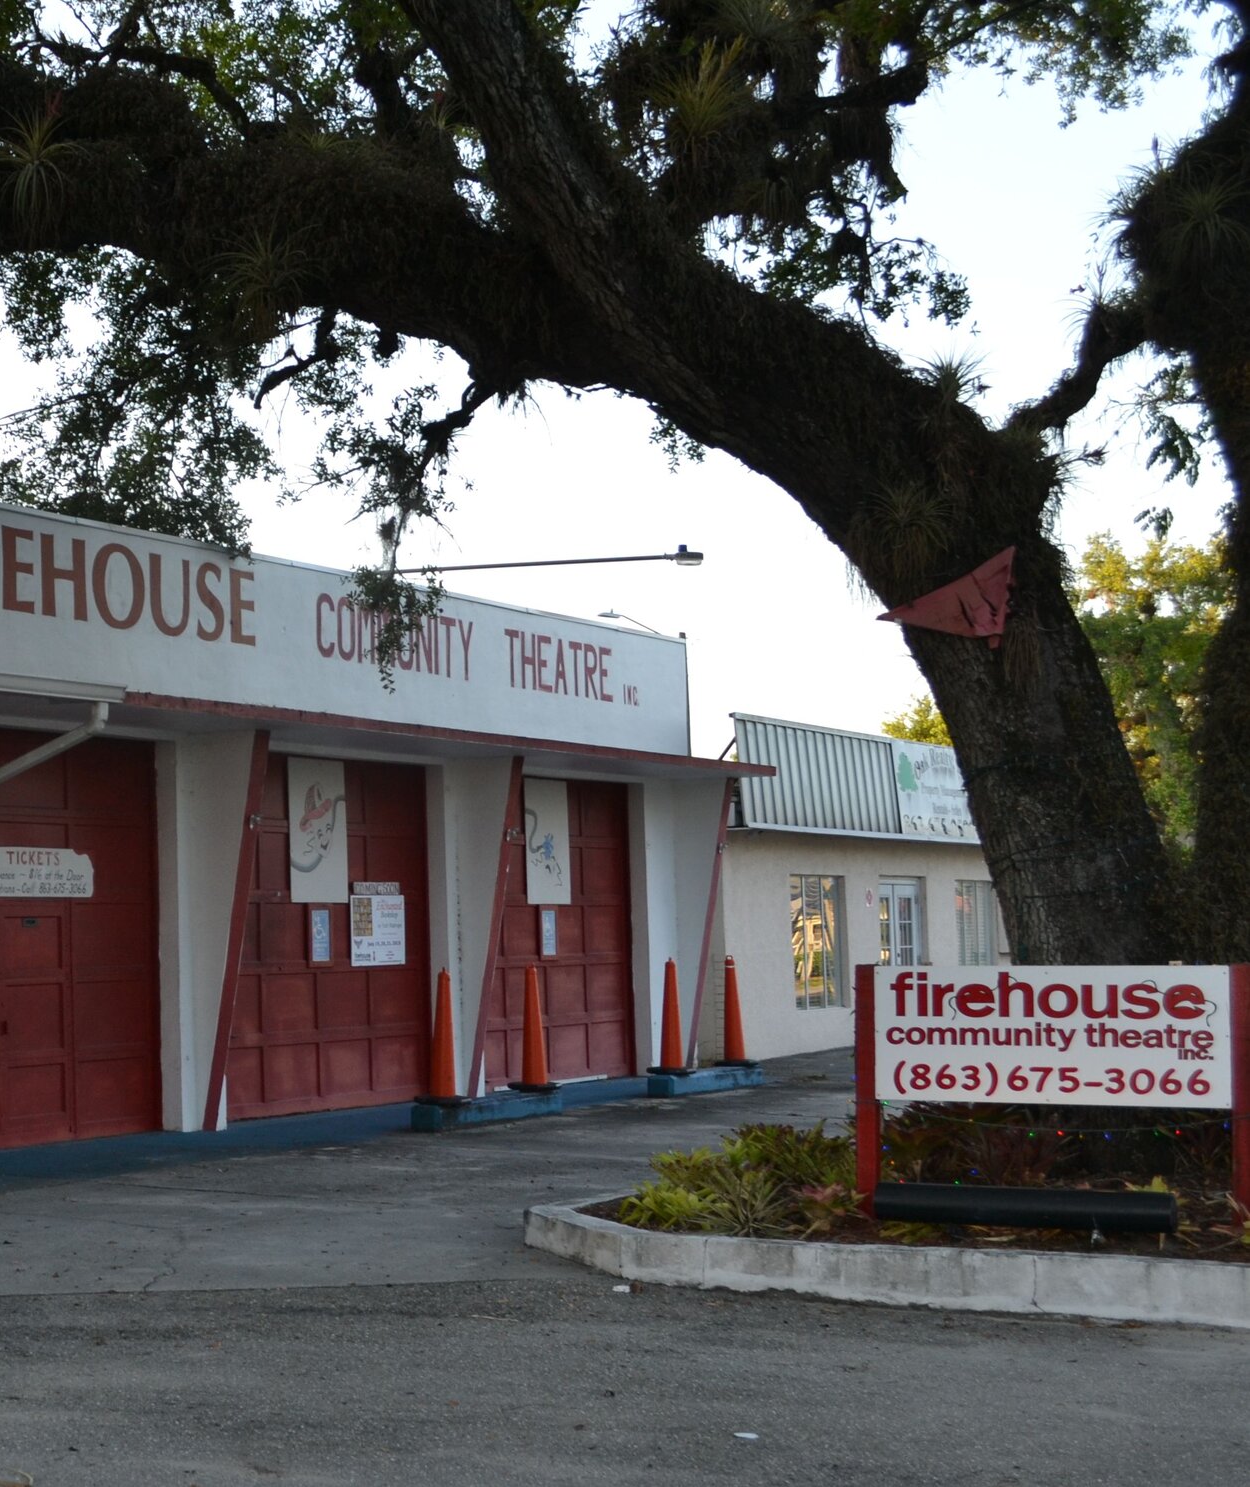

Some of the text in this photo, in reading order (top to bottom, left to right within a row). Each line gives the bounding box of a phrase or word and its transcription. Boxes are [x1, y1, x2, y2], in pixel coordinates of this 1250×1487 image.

[504, 628, 614, 703] THEATRE
[6, 851, 60, 866] TICKETS
[890, 971, 1207, 1020] firehouse
[885, 1022, 1214, 1052] community theatre
[1178, 1048, 1214, 1061] inc.
[893, 1060, 1211, 1097] (863)675-3066
